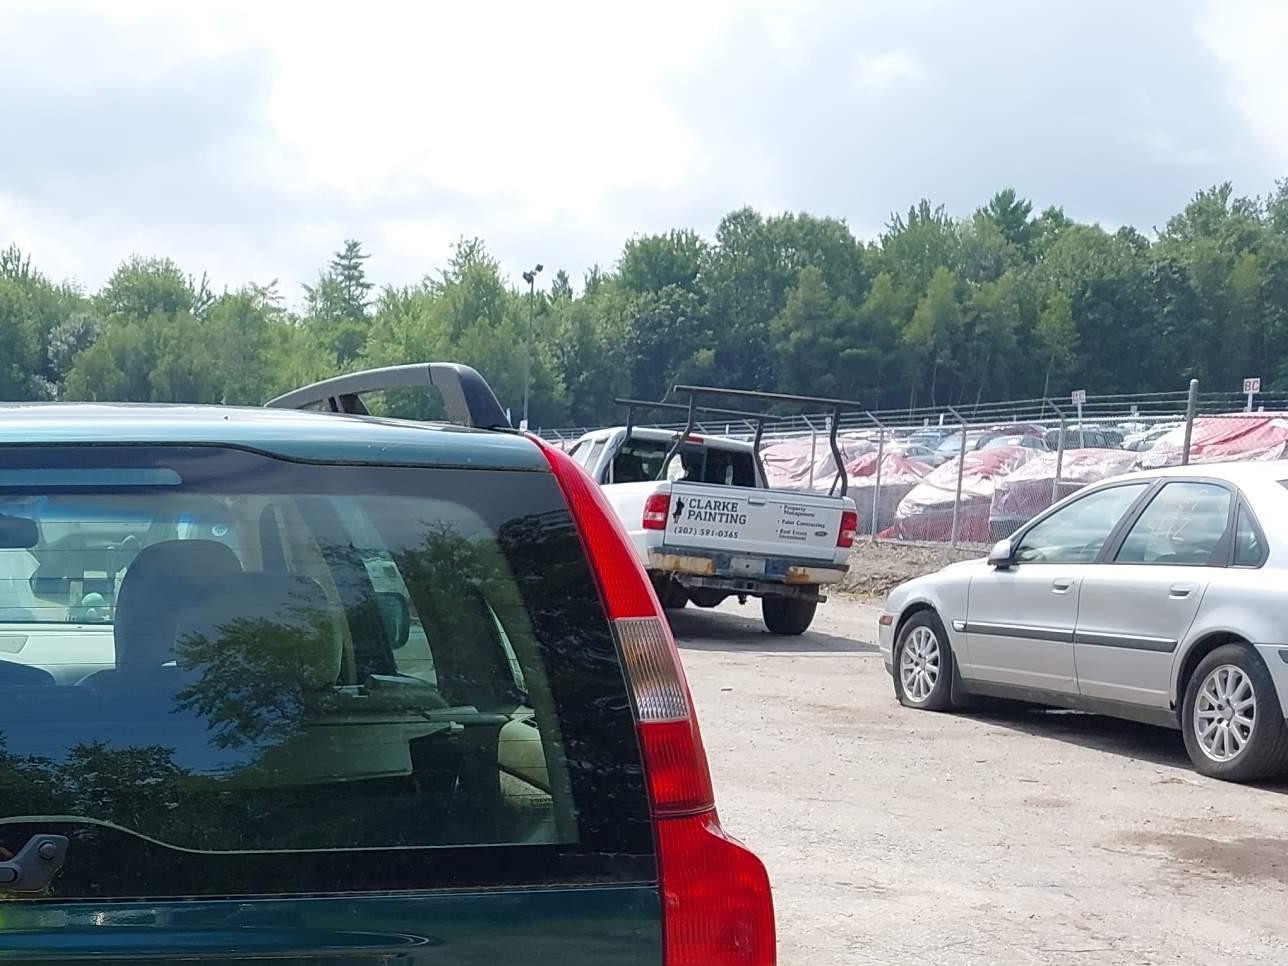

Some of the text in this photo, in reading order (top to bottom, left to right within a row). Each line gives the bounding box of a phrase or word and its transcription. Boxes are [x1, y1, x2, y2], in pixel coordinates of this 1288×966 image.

[1245, 380, 1259, 391] BC
[689, 498, 739, 512] CLARKE
[687, 510, 747, 525] PAINTING
[673, 526, 697, 536] (207)
